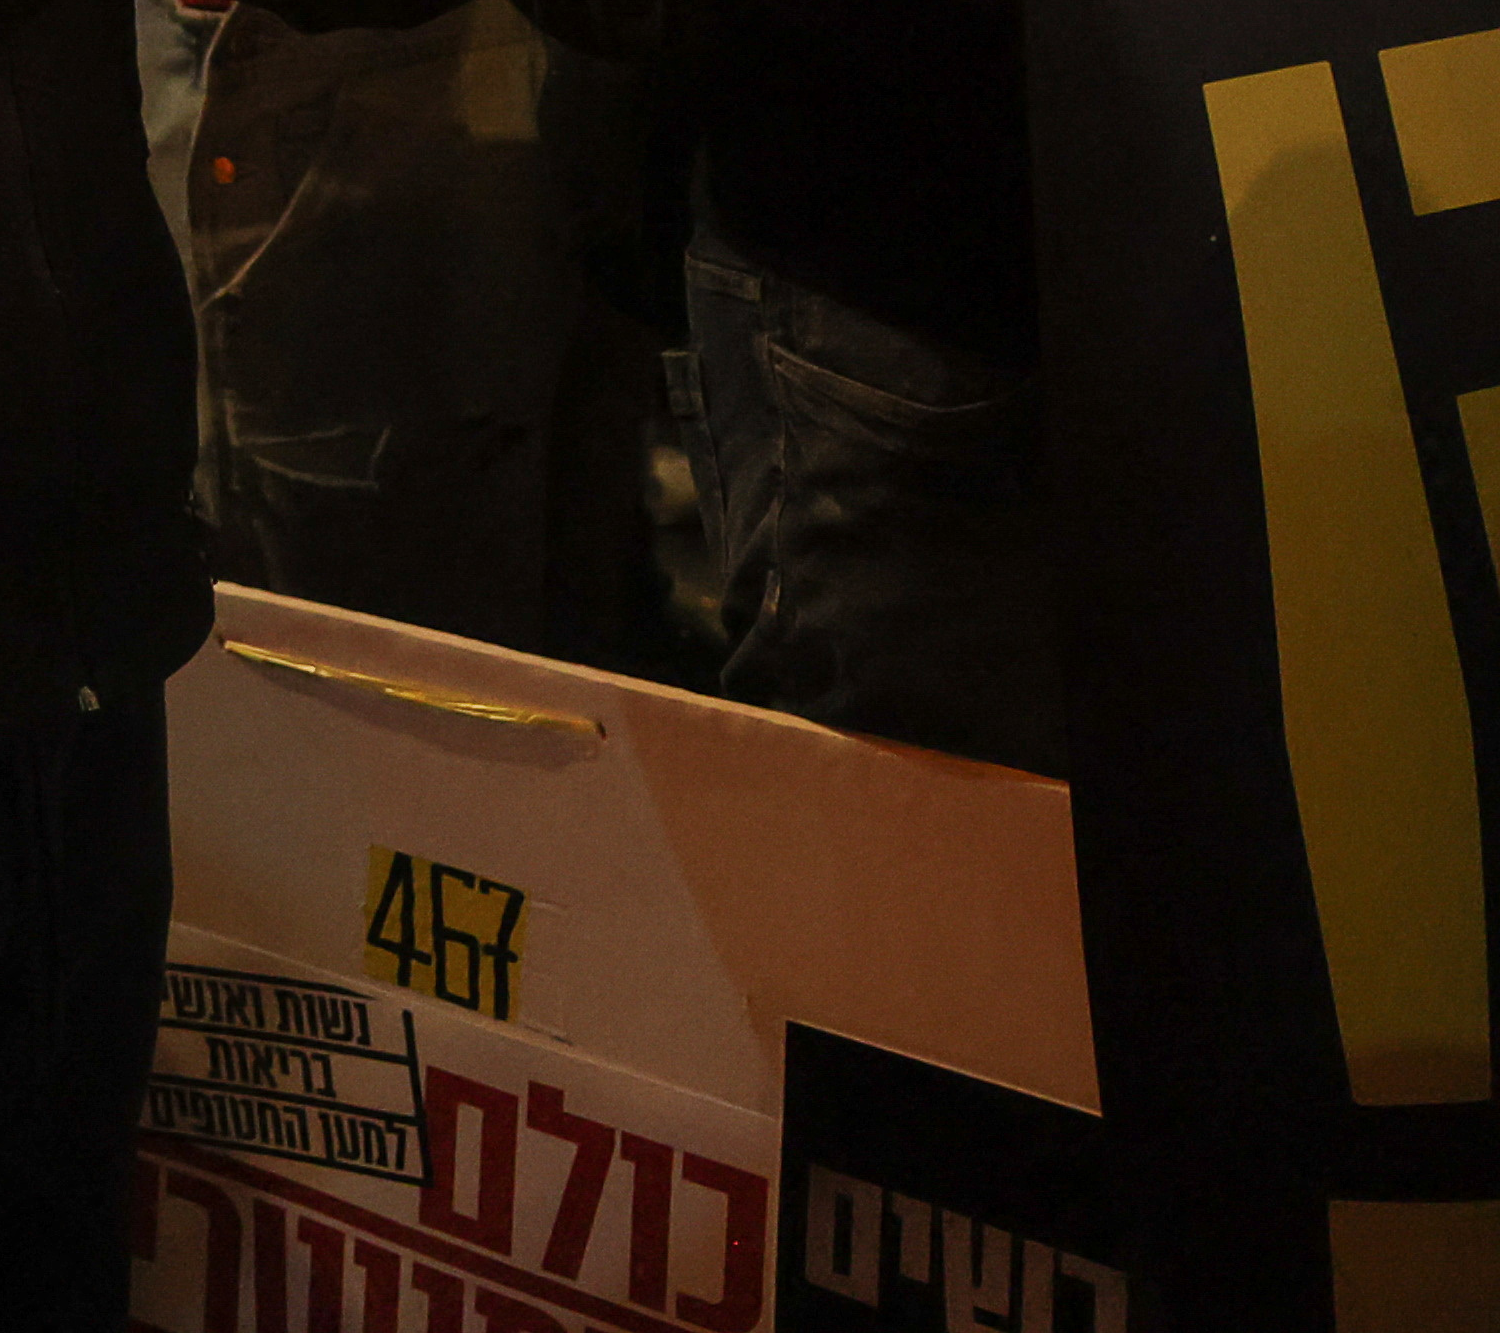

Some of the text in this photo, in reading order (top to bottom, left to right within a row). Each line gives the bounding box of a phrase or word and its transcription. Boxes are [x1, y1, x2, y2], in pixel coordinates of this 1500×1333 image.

[366, 850, 526, 1021] 467
[274, 988, 372, 1047] נשות
[205, 1035, 337, 1099] בריאות
[151, 1086, 407, 1172] למען החטופים
[418, 1064, 769, 1333] כולם
